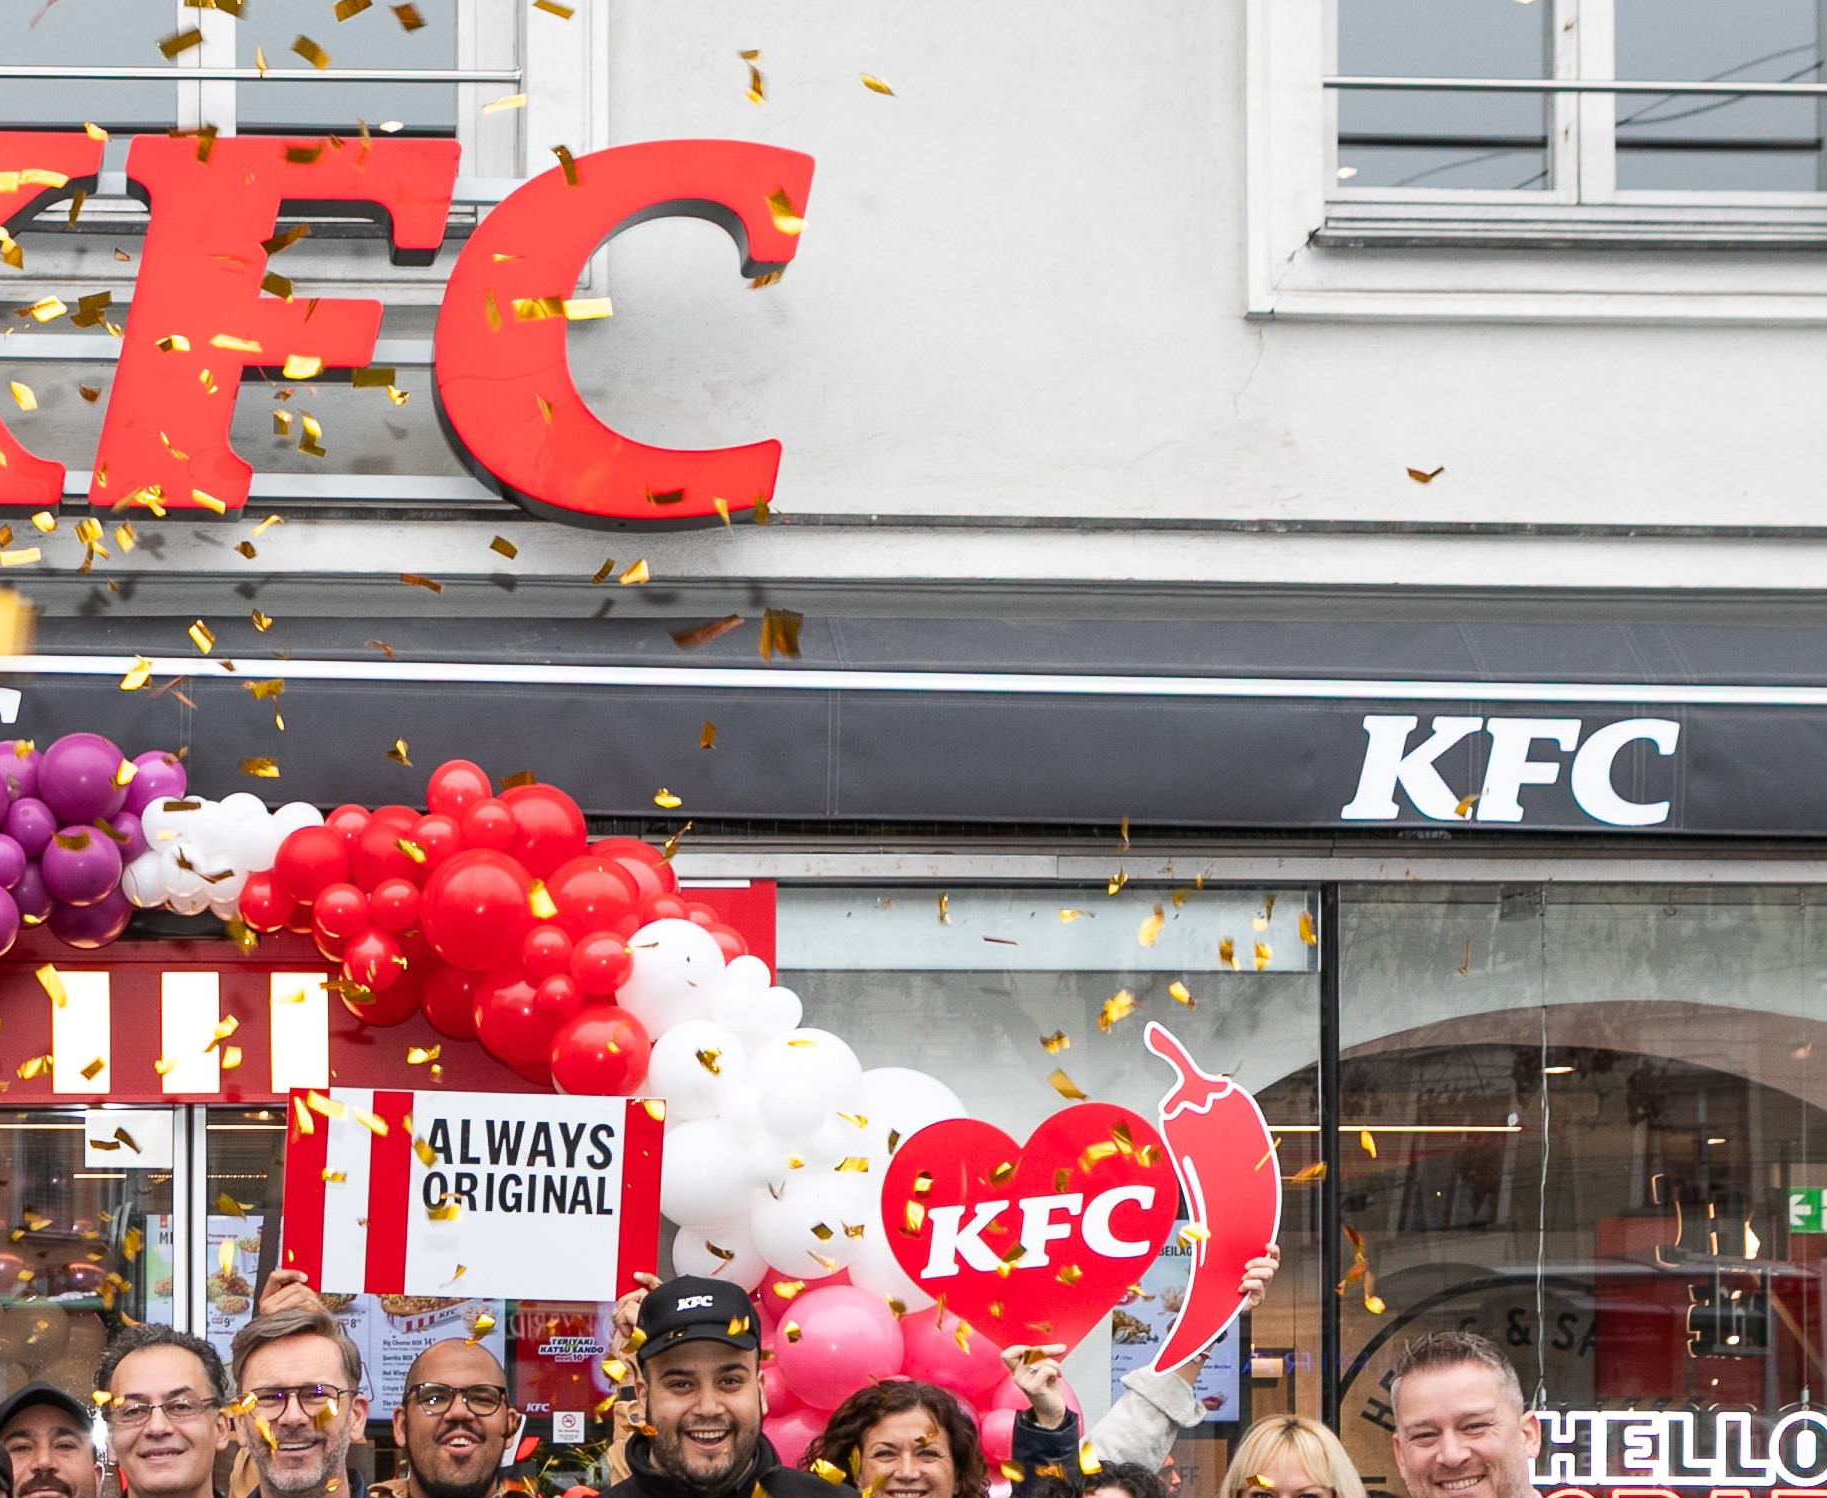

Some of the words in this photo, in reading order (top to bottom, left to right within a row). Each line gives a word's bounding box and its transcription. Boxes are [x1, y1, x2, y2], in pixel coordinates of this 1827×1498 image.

[1341, 715, 1680, 825] KFC
[426, 1119, 615, 1169] ALWAYS
[422, 1172, 613, 1214] ORIGINAL
[921, 1186, 1154, 1279] KFC
[438, 1307, 458, 1319] KFC
[676, 1295, 713, 1311] KFC
[394, 1369, 408, 1377] Wing
[526, 1403, 549, 1412] KFC
[1528, 1411, 1827, 1488] HELLO
